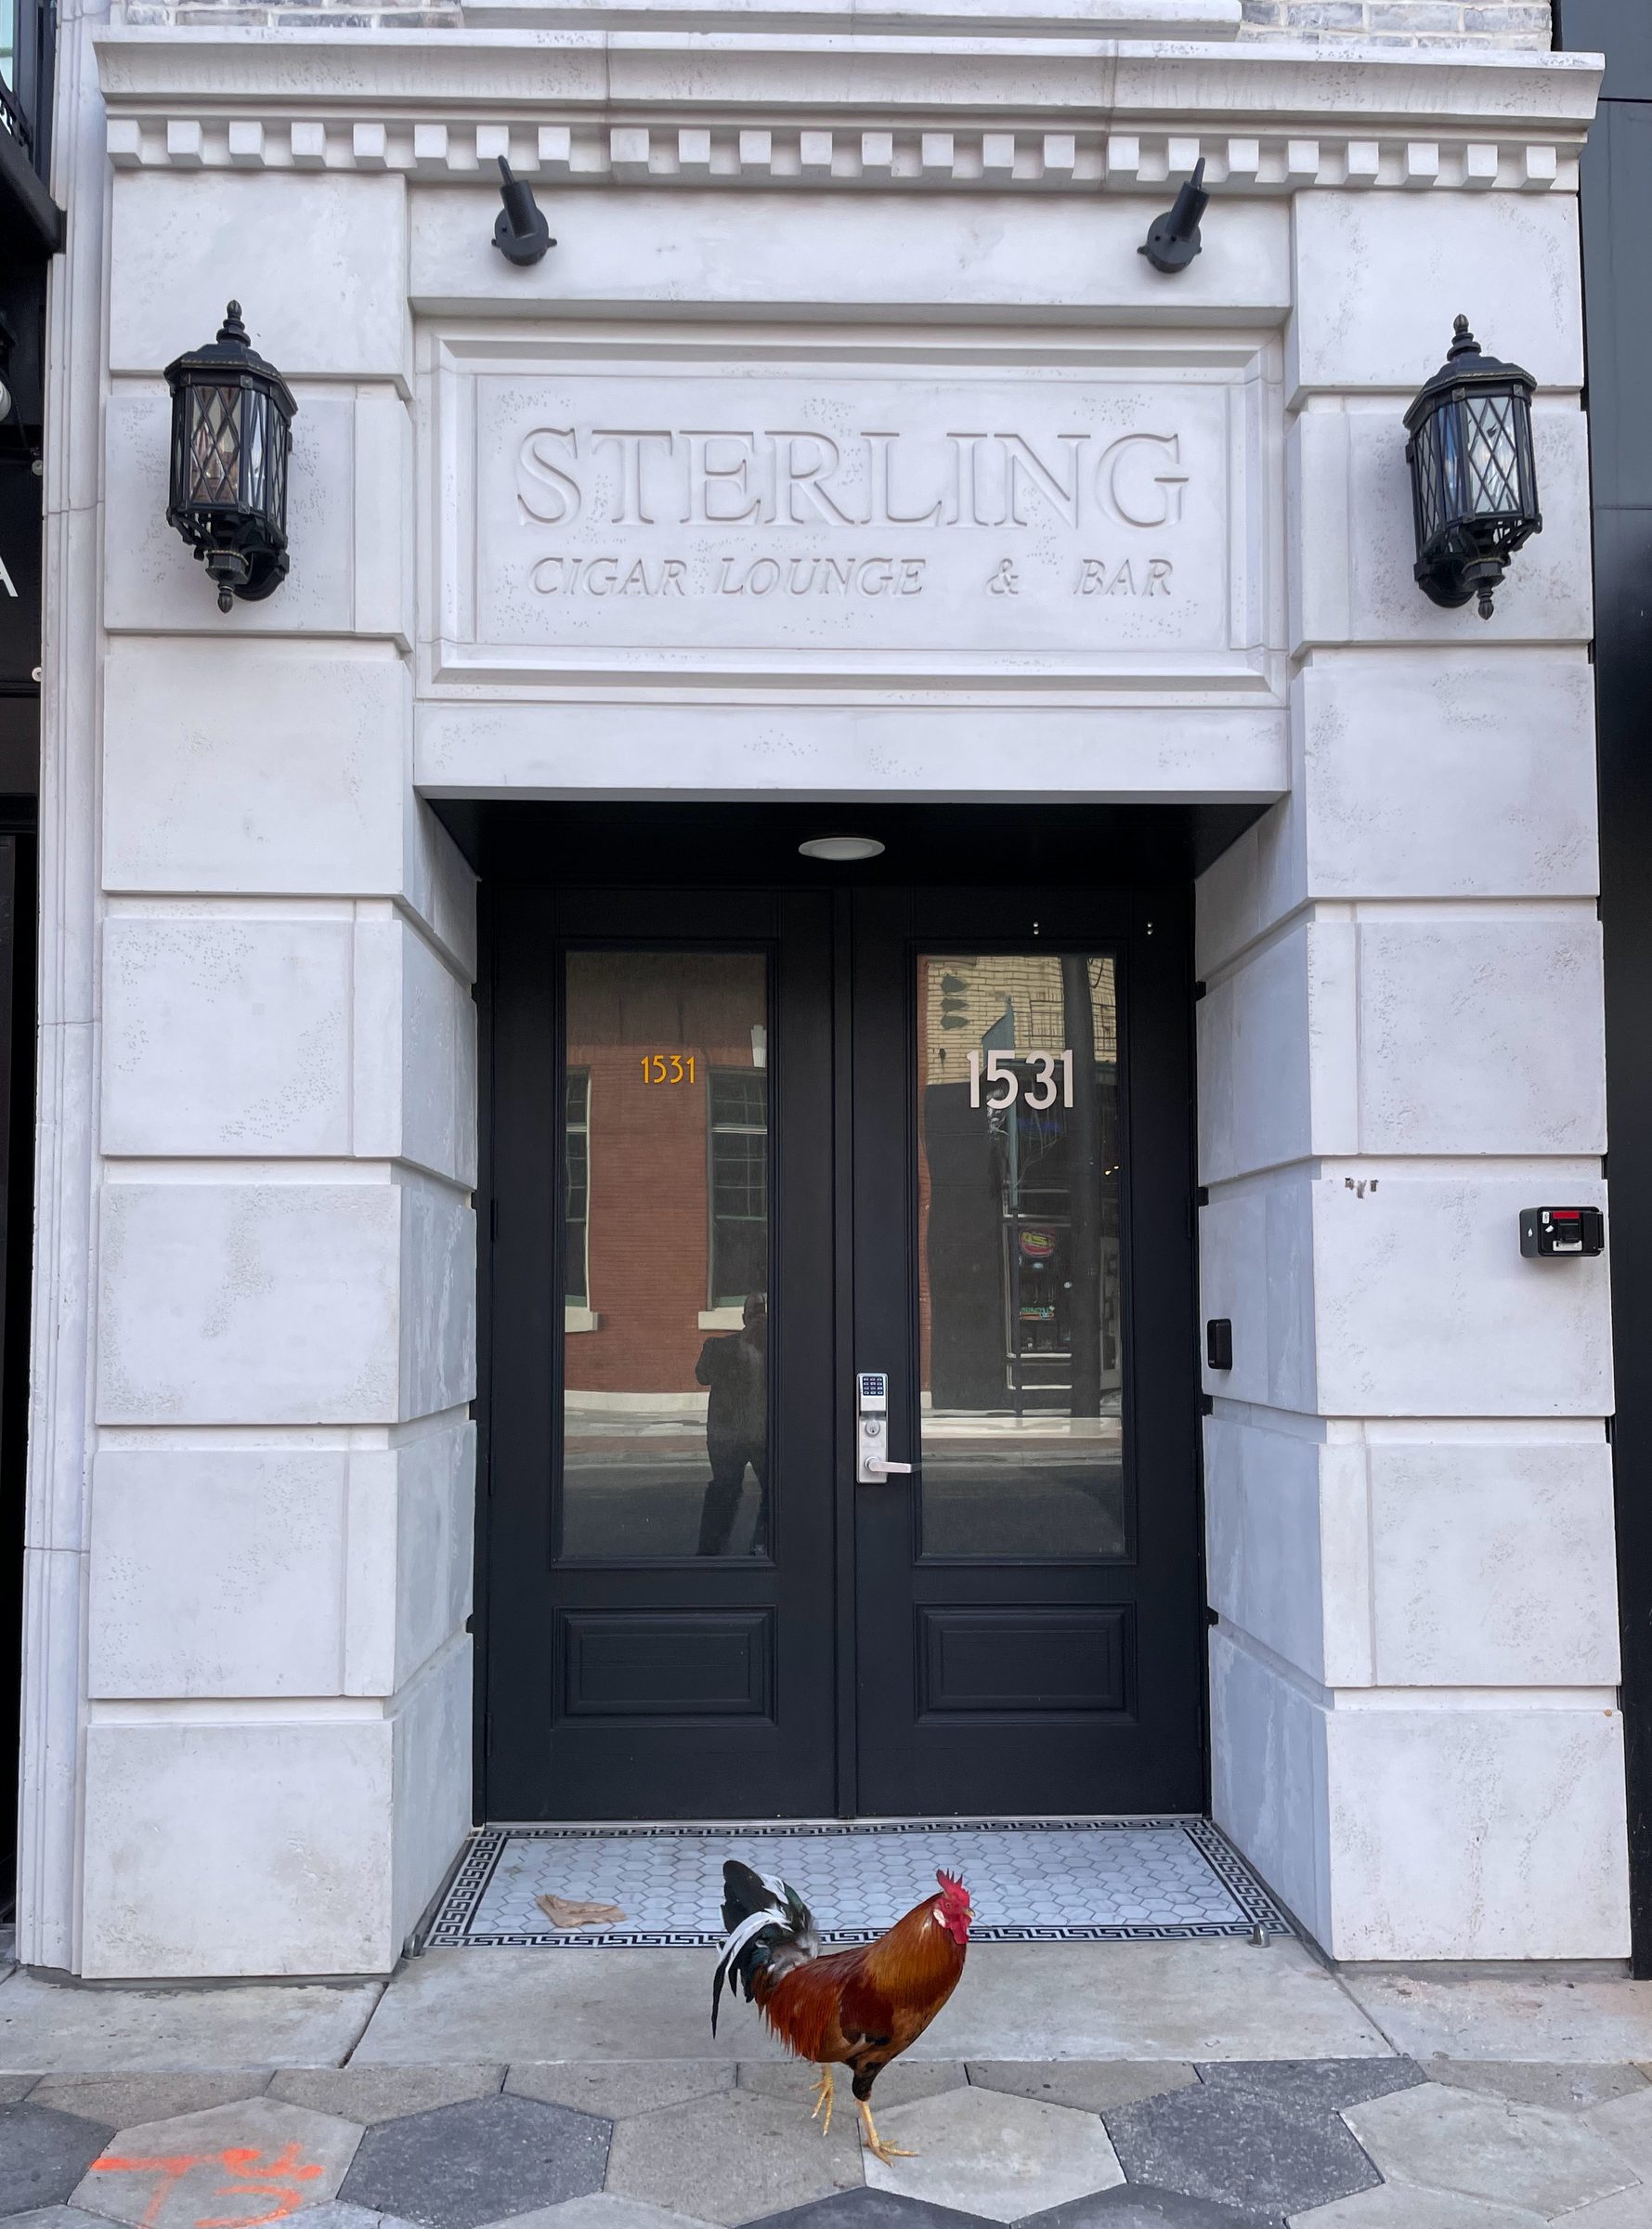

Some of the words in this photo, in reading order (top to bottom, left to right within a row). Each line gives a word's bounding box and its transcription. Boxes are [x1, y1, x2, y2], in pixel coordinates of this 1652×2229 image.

[517, 427, 1190, 528] STERLING
[528, 556, 687, 597] CIGAR
[714, 556, 926, 597] LOUNGE
[985, 557, 1020, 596] &
[1073, 558, 1174, 597] BAR
[641, 1054, 696, 1085] 1531
[967, 1049, 1073, 1110] 1531
